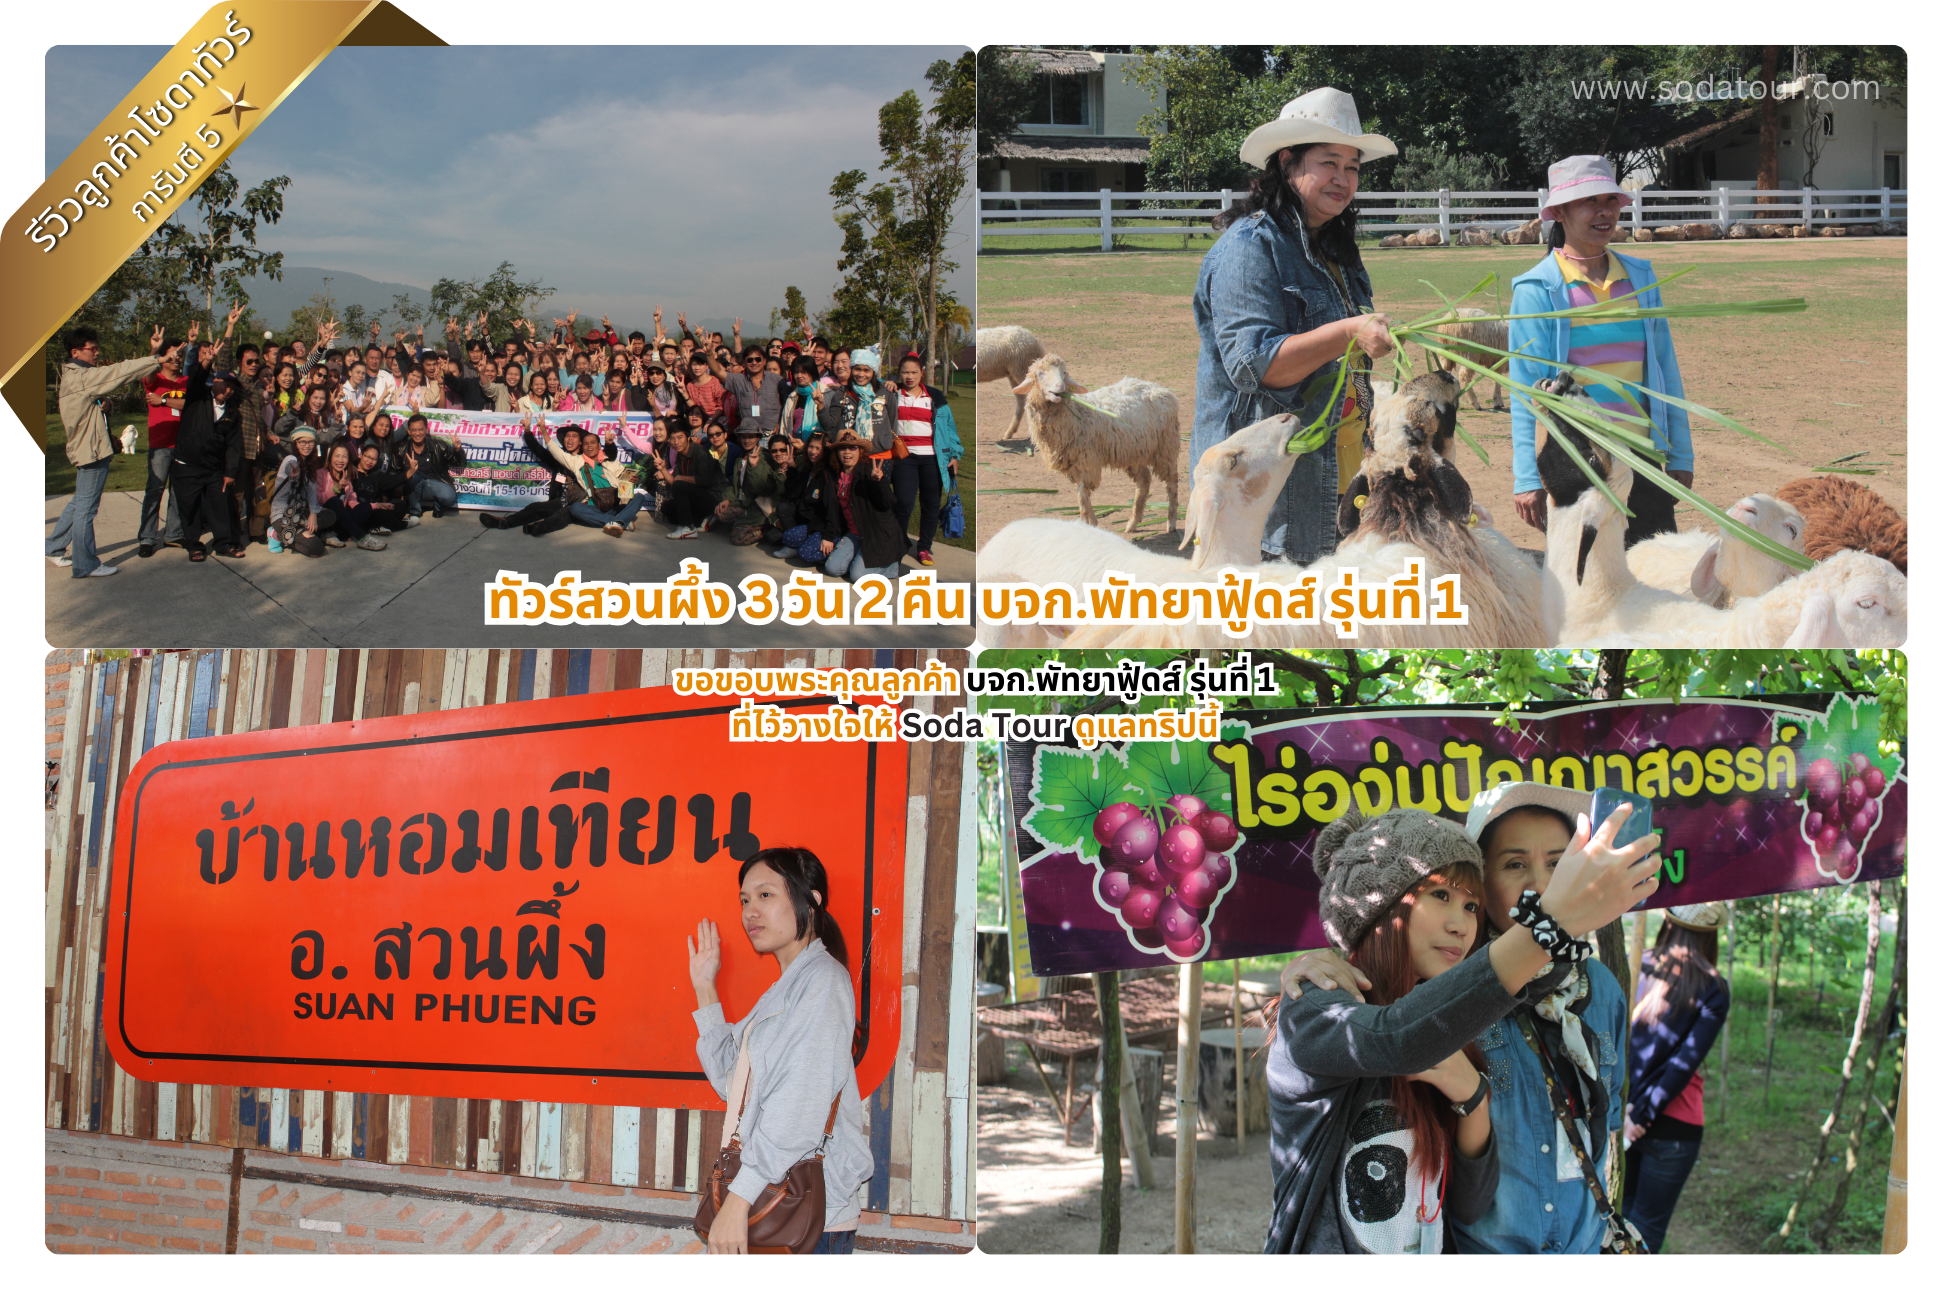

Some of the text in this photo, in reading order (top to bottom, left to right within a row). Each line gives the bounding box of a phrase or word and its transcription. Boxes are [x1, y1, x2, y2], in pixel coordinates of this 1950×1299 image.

[495, 485, 527, 496] 15-16
[196, 767, 762, 885] บ้านหอมเทียน
[291, 880, 606, 981] อ. สวนผึ้ง
[293, 992, 597, 1026] SUAN PHUENG
